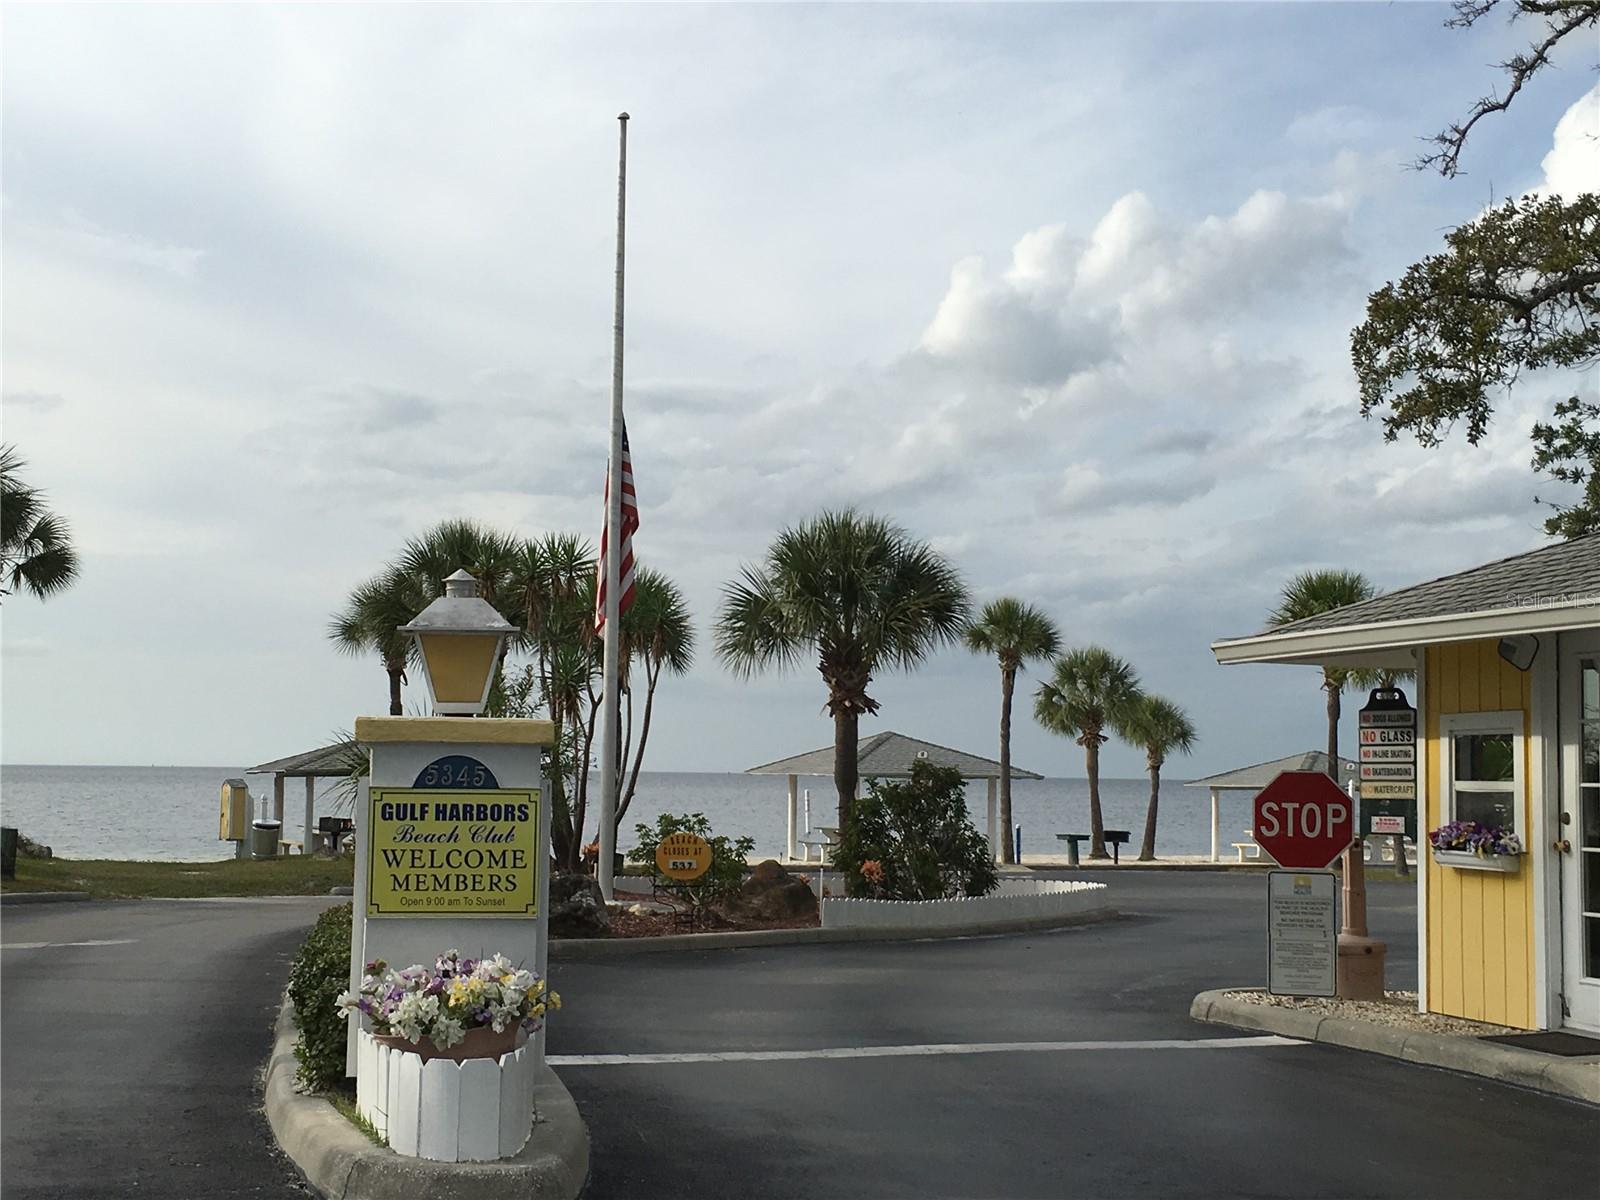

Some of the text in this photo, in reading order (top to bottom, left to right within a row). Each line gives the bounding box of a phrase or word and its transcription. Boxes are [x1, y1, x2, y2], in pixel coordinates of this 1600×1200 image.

[1362, 730, 1412, 742] NO GLASS
[1362, 750, 1371, 758] NO
[1390, 750, 1412, 758] SKATING
[425, 764, 486, 787] 5345
[1362, 767, 1371, 777] NO
[1374, 785, 1414, 794] WATERCRAFT
[381, 802, 529, 822] GULF HARBORS
[1260, 802, 1347, 838] STOP
[393, 824, 516, 844] Beach Club
[670, 835, 698, 845] BEACH
[663, 846, 702, 856] CLOSES AT
[381, 849, 528, 869] WELCOME
[390, 873, 518, 892] MEMBERS
[400, 897, 506, 908] Open 9:00 am To Sunset
